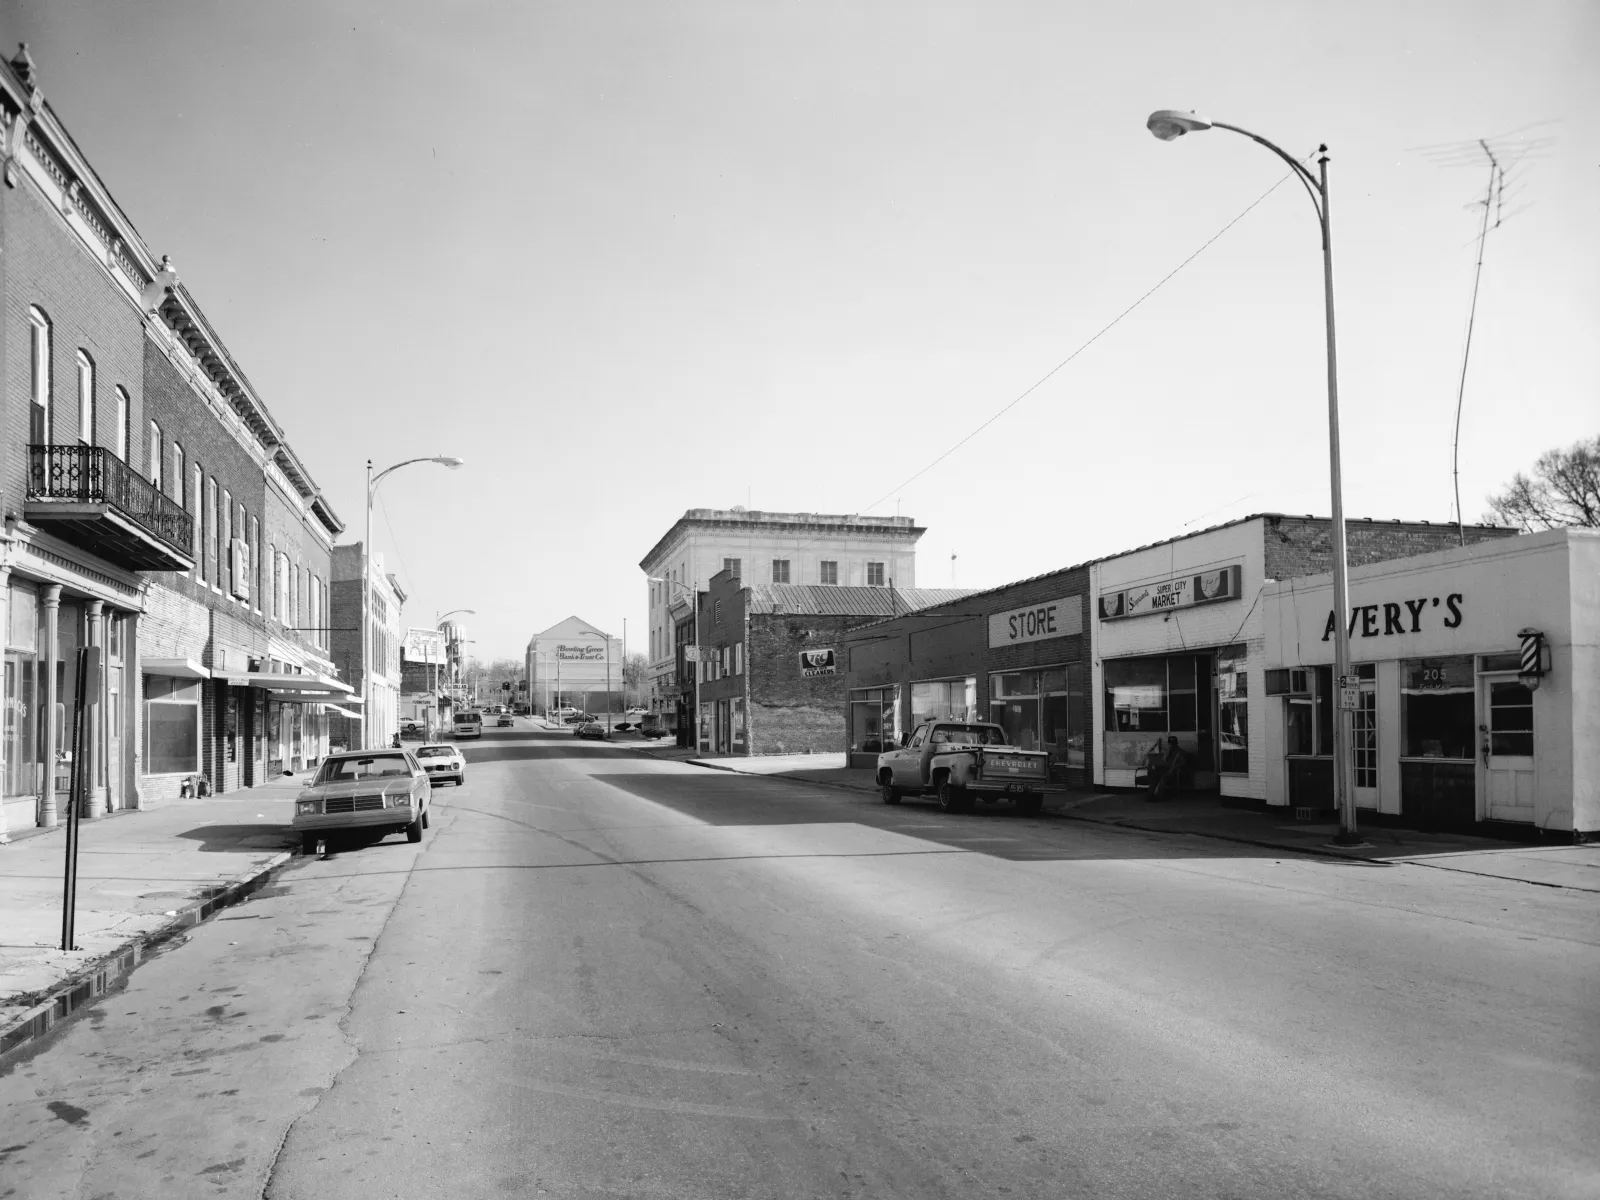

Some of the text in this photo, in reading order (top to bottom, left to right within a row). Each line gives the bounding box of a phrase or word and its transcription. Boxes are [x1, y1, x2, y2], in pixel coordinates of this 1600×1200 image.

[1156, 580, 1187, 595] SUPER CITY
[1151, 592, 1181, 609] MARKET
[1009, 605, 1057, 640] STORE
[1321, 593, 1463, 641] AVERY'S
[557, 645, 604, 654] Bowling Green
[805, 669, 834, 677] CLEANERS
[1423, 668, 1448, 681] 205
[990, 759, 1038, 769] CHEVROLET
